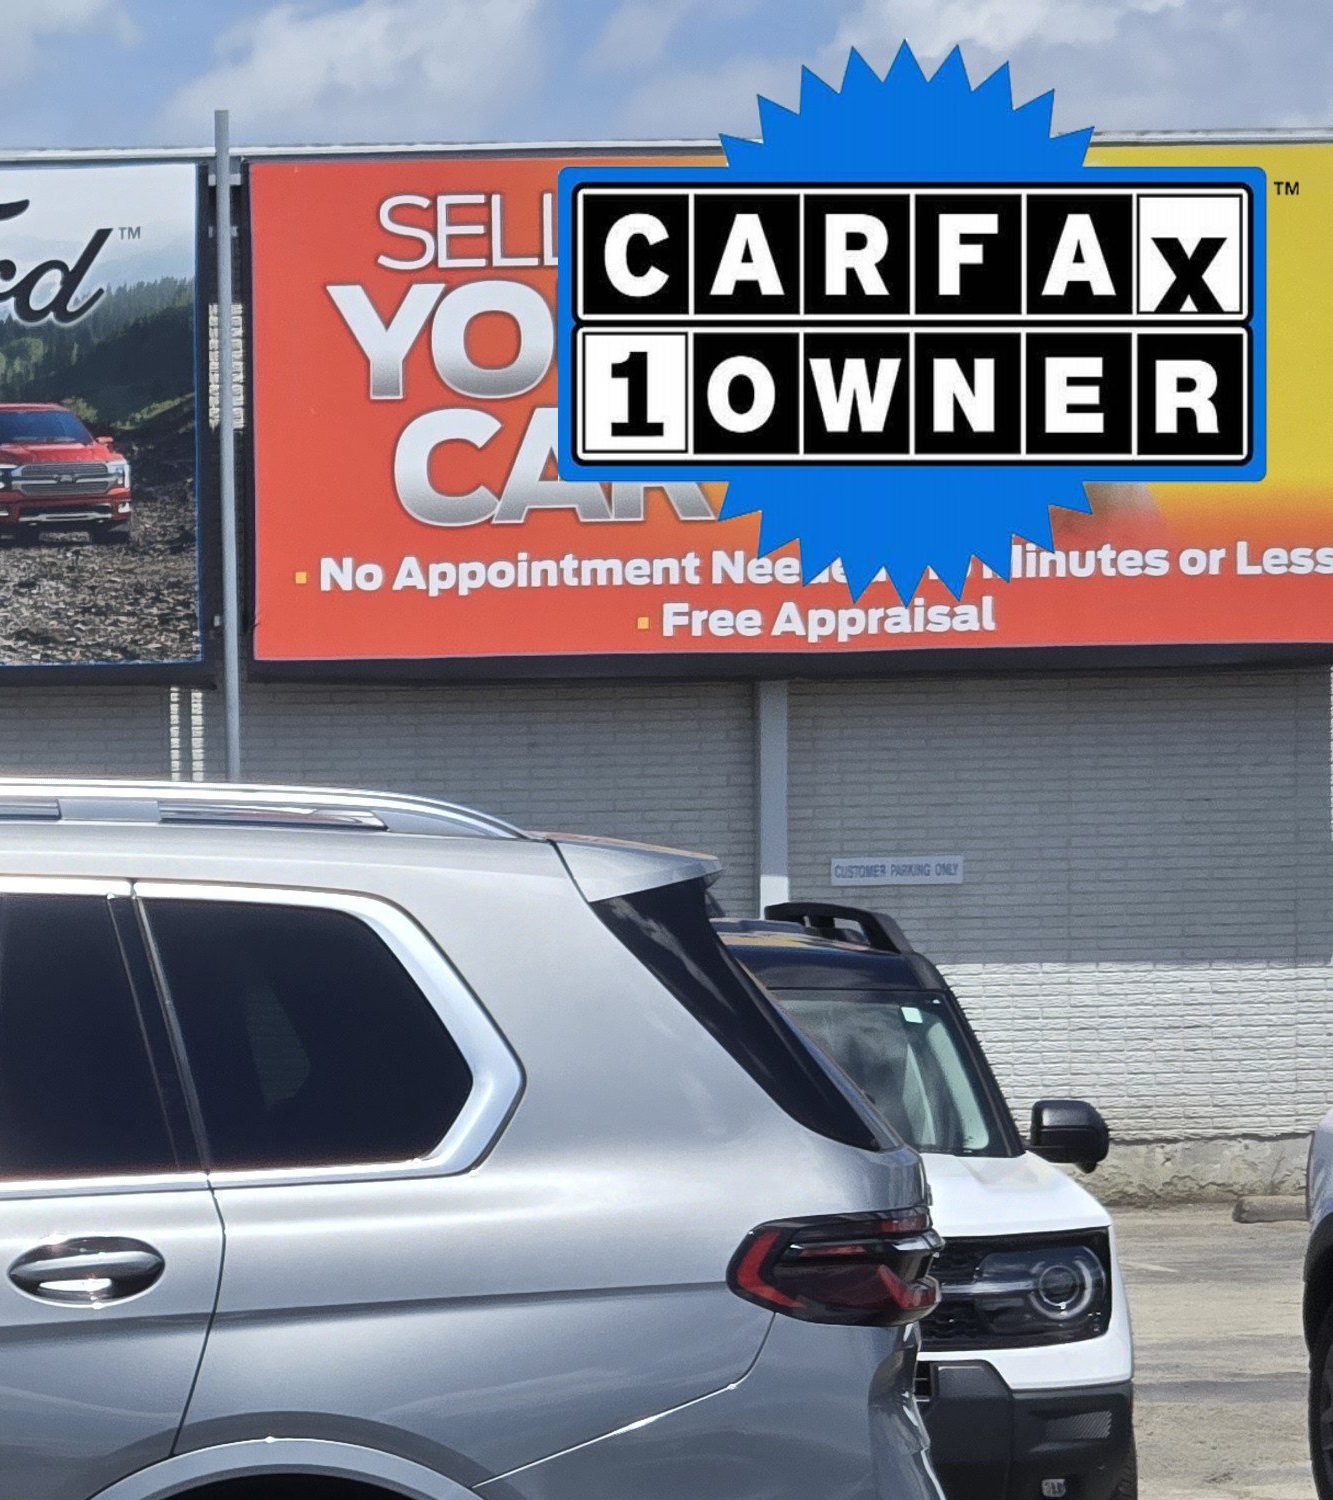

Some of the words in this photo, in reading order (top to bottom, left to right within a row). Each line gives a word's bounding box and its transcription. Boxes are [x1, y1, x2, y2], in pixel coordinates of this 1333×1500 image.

[325, 280, 556, 400] YO
[393, 407, 716, 527] CA
[319, 556, 384, 592] No
[391, 552, 701, 597] Appointment
[1178, 547, 1227, 576] or
[661, 601, 763, 638] Free
[770, 595, 997, 644] Appraisal
[834, 864, 887, 879] CUSTOMER
[890, 863, 931, 877] PARKING
[934, 862, 959, 877] ONLY
